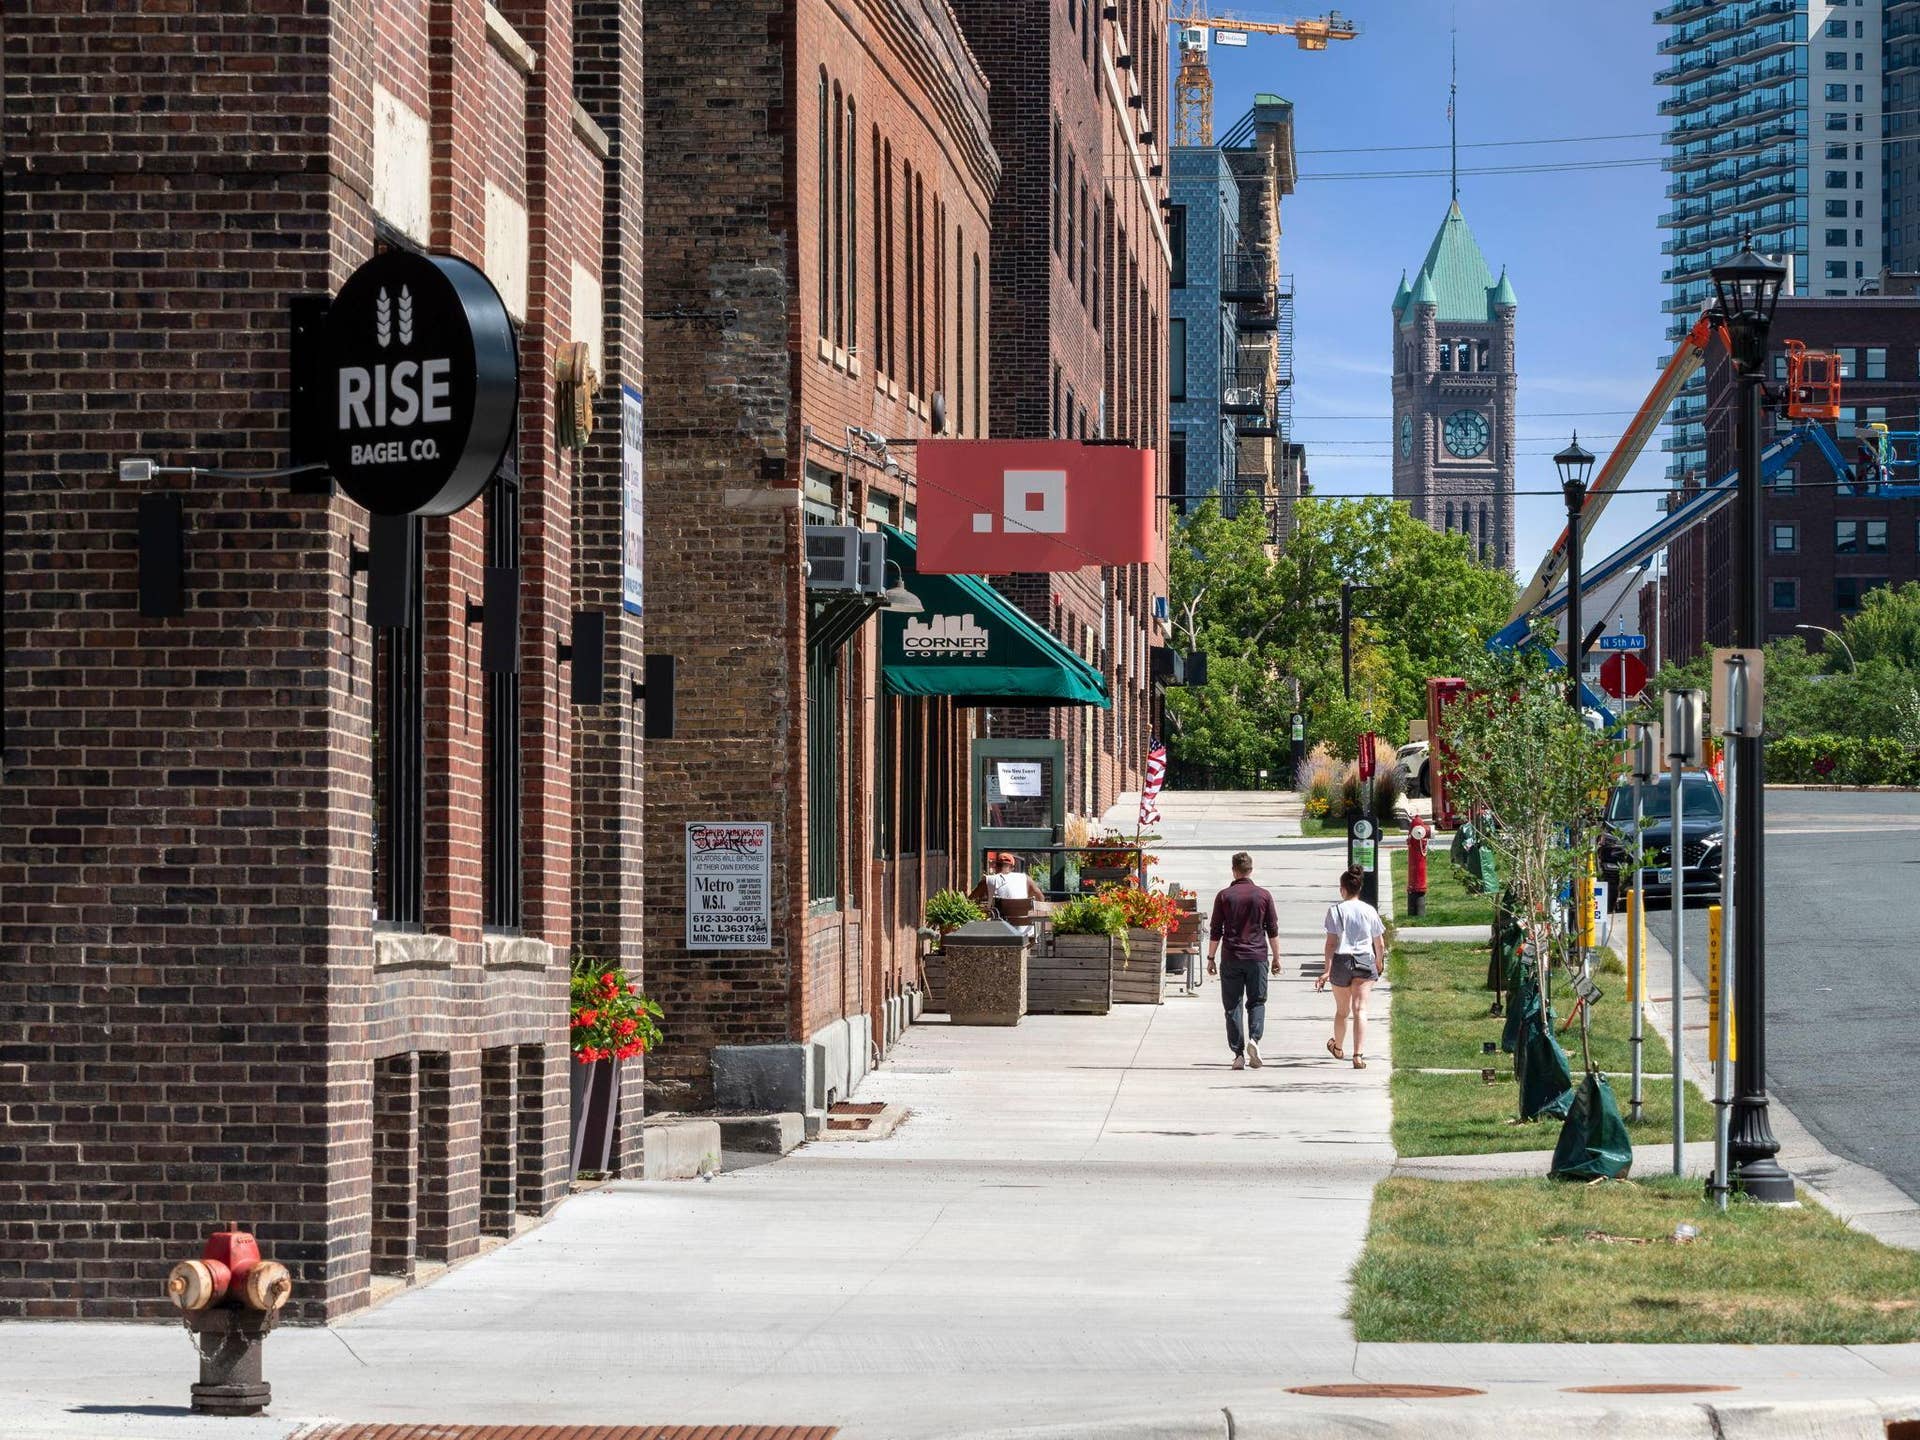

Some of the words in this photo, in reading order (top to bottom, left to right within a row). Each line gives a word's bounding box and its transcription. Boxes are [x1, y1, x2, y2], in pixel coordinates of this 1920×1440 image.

[339, 358, 451, 430] RISE
[351, 441, 408, 465] BAGEL
[410, 438, 440, 460] CO.
[905, 637, 986, 648] CORNER
[1603, 638, 1609, 647] N
[1612, 638, 1627, 647] 5th
[1630, 638, 1641, 647] Av
[753, 829, 765, 837] FOR
[692, 854, 721, 862] VIOLATORS
[722, 854, 735, 862] WILL
[736, 854, 744, 862] BE
[745, 854, 764, 862] TOWED
[696, 863, 703, 871] AT
[703, 863, 720, 871] THEIR
[721, 863, 734, 871] OWN
[735, 863, 760, 871] EXPENSE
[694, 876, 734, 892] Metro
[702, 894, 726, 910] W.S.I.
[693, 915, 761, 923] 612-330-0013
[693, 924, 714, 933] LIC.
[717, 924, 756, 933] L36374
[729, 934, 745, 942] FEE
